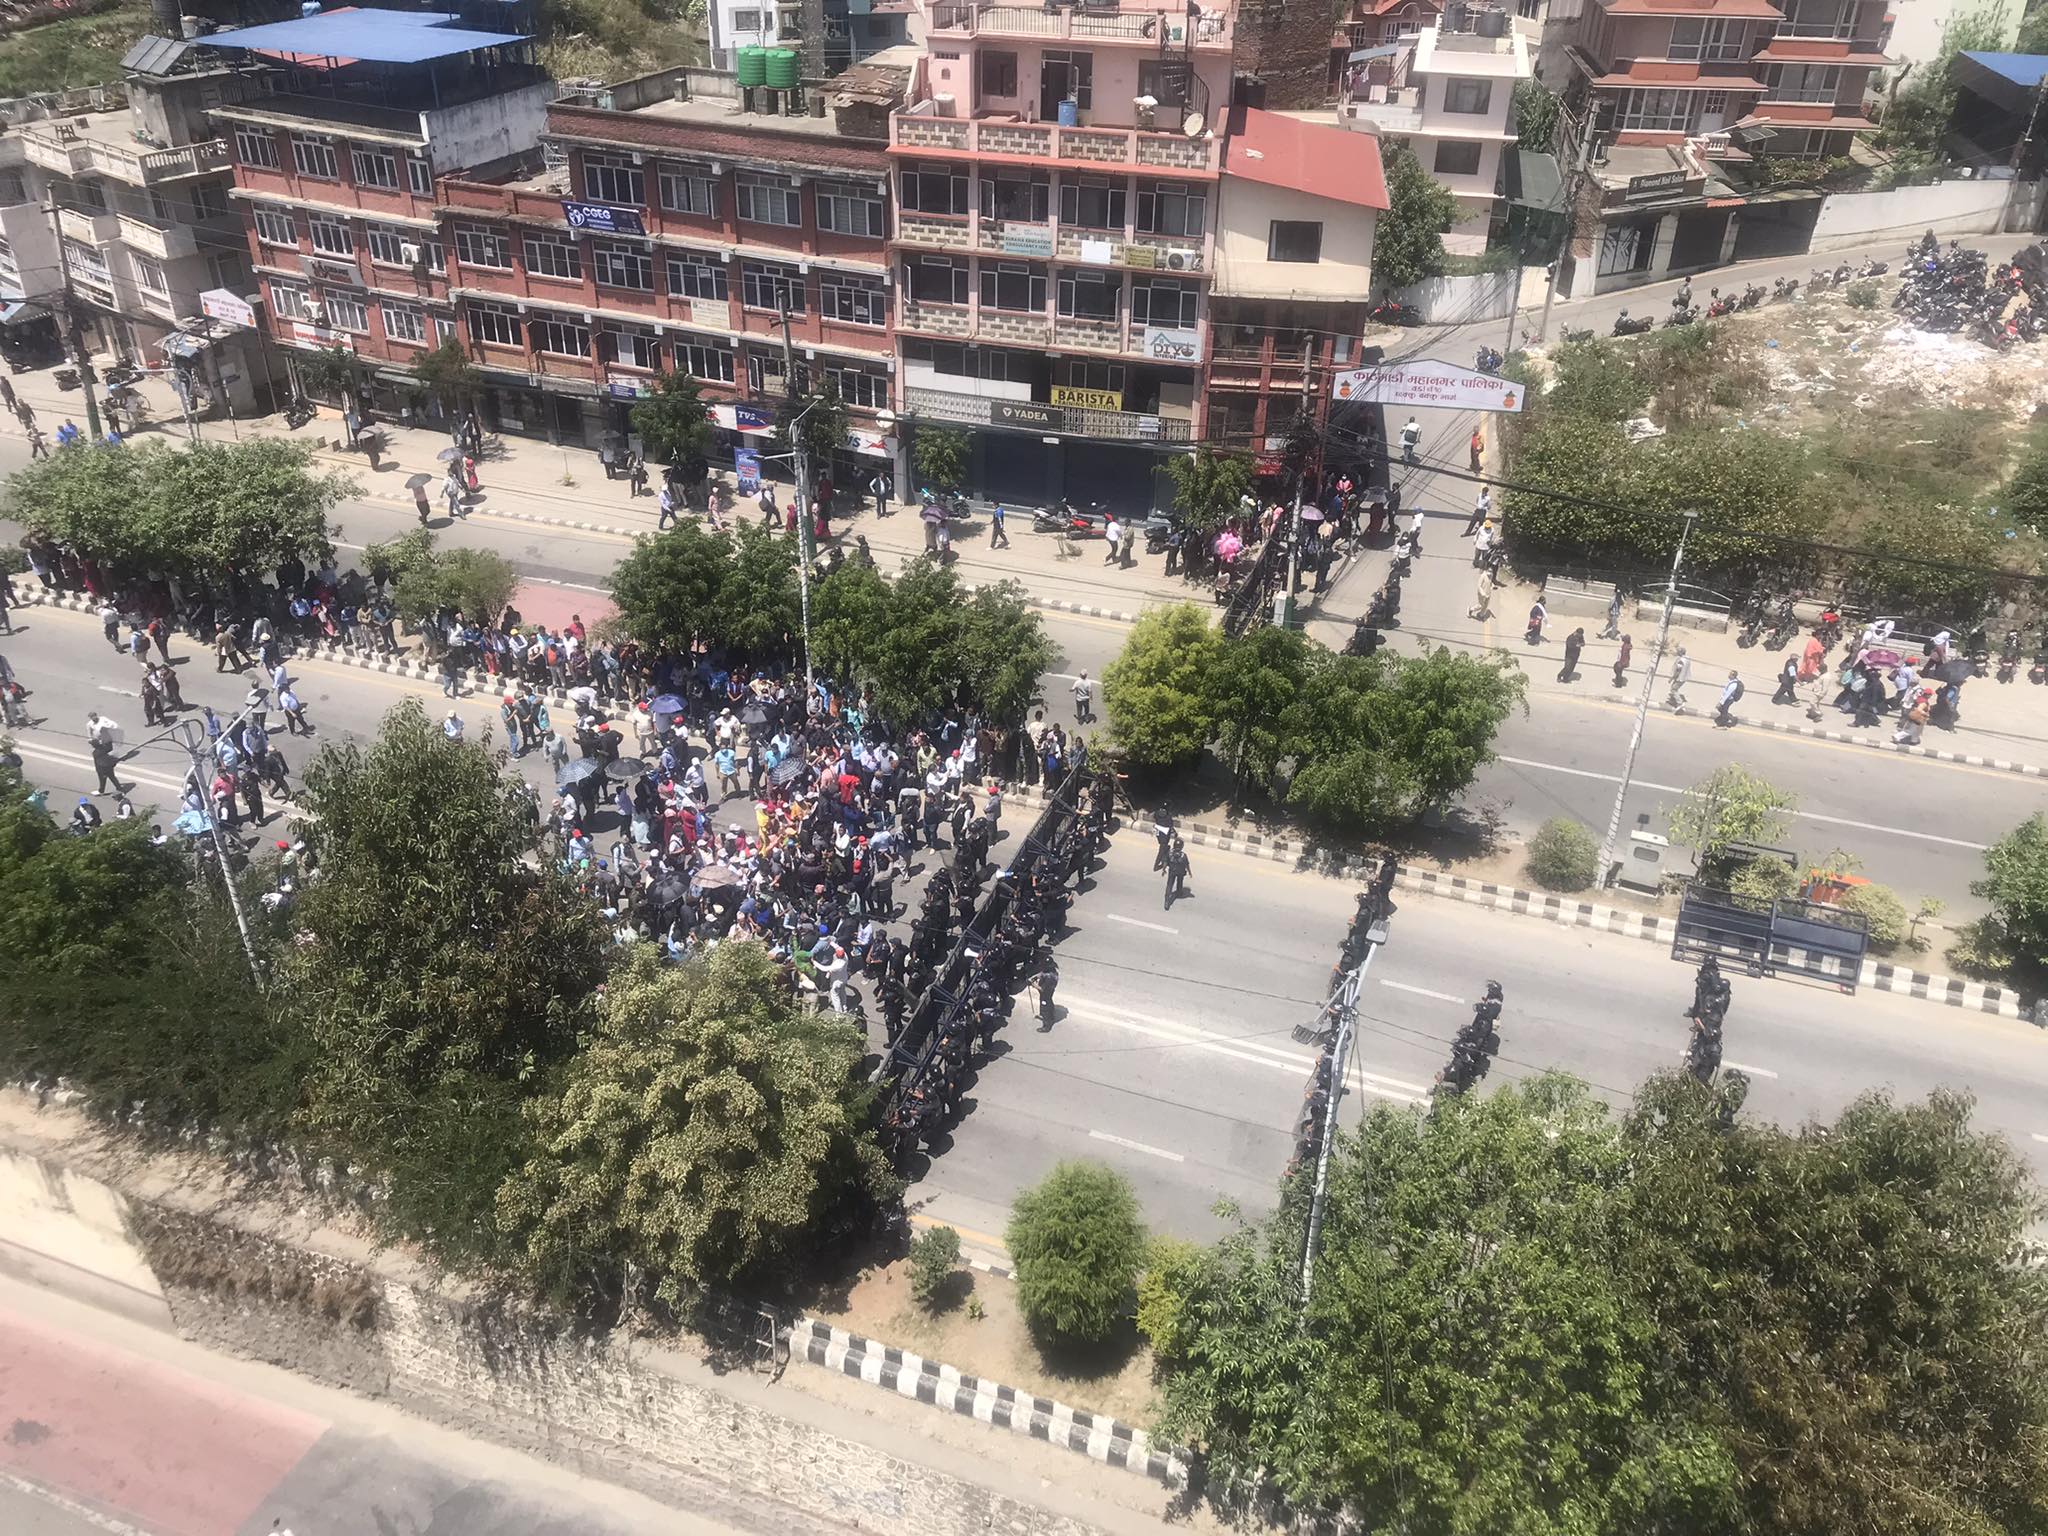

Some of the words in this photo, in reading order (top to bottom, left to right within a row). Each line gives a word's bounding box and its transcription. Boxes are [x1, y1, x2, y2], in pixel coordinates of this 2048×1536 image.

[1057, 390, 1116, 407] BARISTA
[738, 409, 756, 421] TVS
[1014, 408, 1049, 422] YADEA
